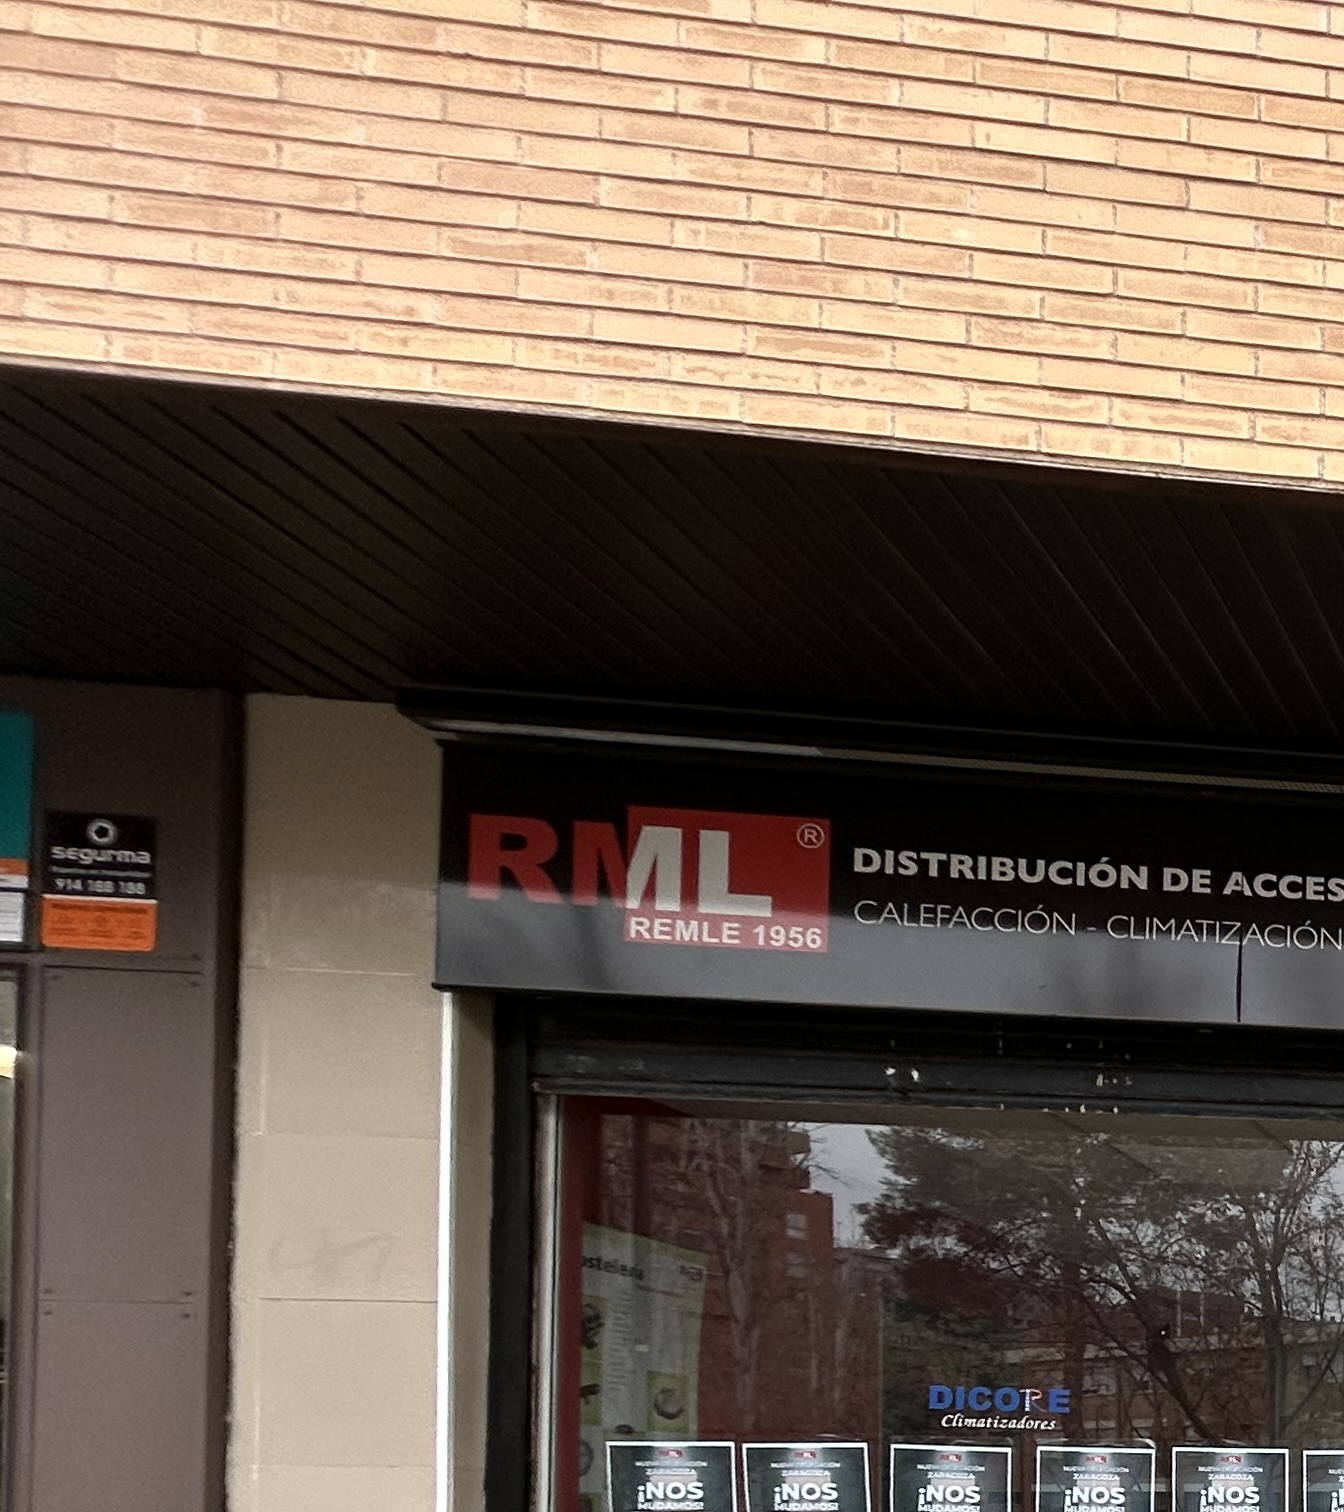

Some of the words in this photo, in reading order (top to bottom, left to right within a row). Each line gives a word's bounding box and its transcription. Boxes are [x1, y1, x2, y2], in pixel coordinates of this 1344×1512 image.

[51, 846, 151, 864] segurma
[469, 813, 772, 917] RML
[854, 848, 1148, 891] DISTRIBUCIÓN
[1163, 868, 1210, 894] DE
[629, 917, 740, 944] REMLE
[753, 924, 822, 949] 1956
[854, 900, 1077, 936] CALEFACCIÓN
[1107, 914, 1343, 951] CLIMATIZACIÓN
[928, 1385, 1071, 1413] DICORE
[941, 1414, 1056, 1430] Climatizadores
[637, 1482, 704, 1502] ¡NOS
[774, 1483, 838, 1503] ¡NOS
[918, 1486, 981, 1506] ¡NOS
[1065, 1487, 1125, 1506] ¡NOS
[1201, 1487, 1259, 1506] ¡NOS
